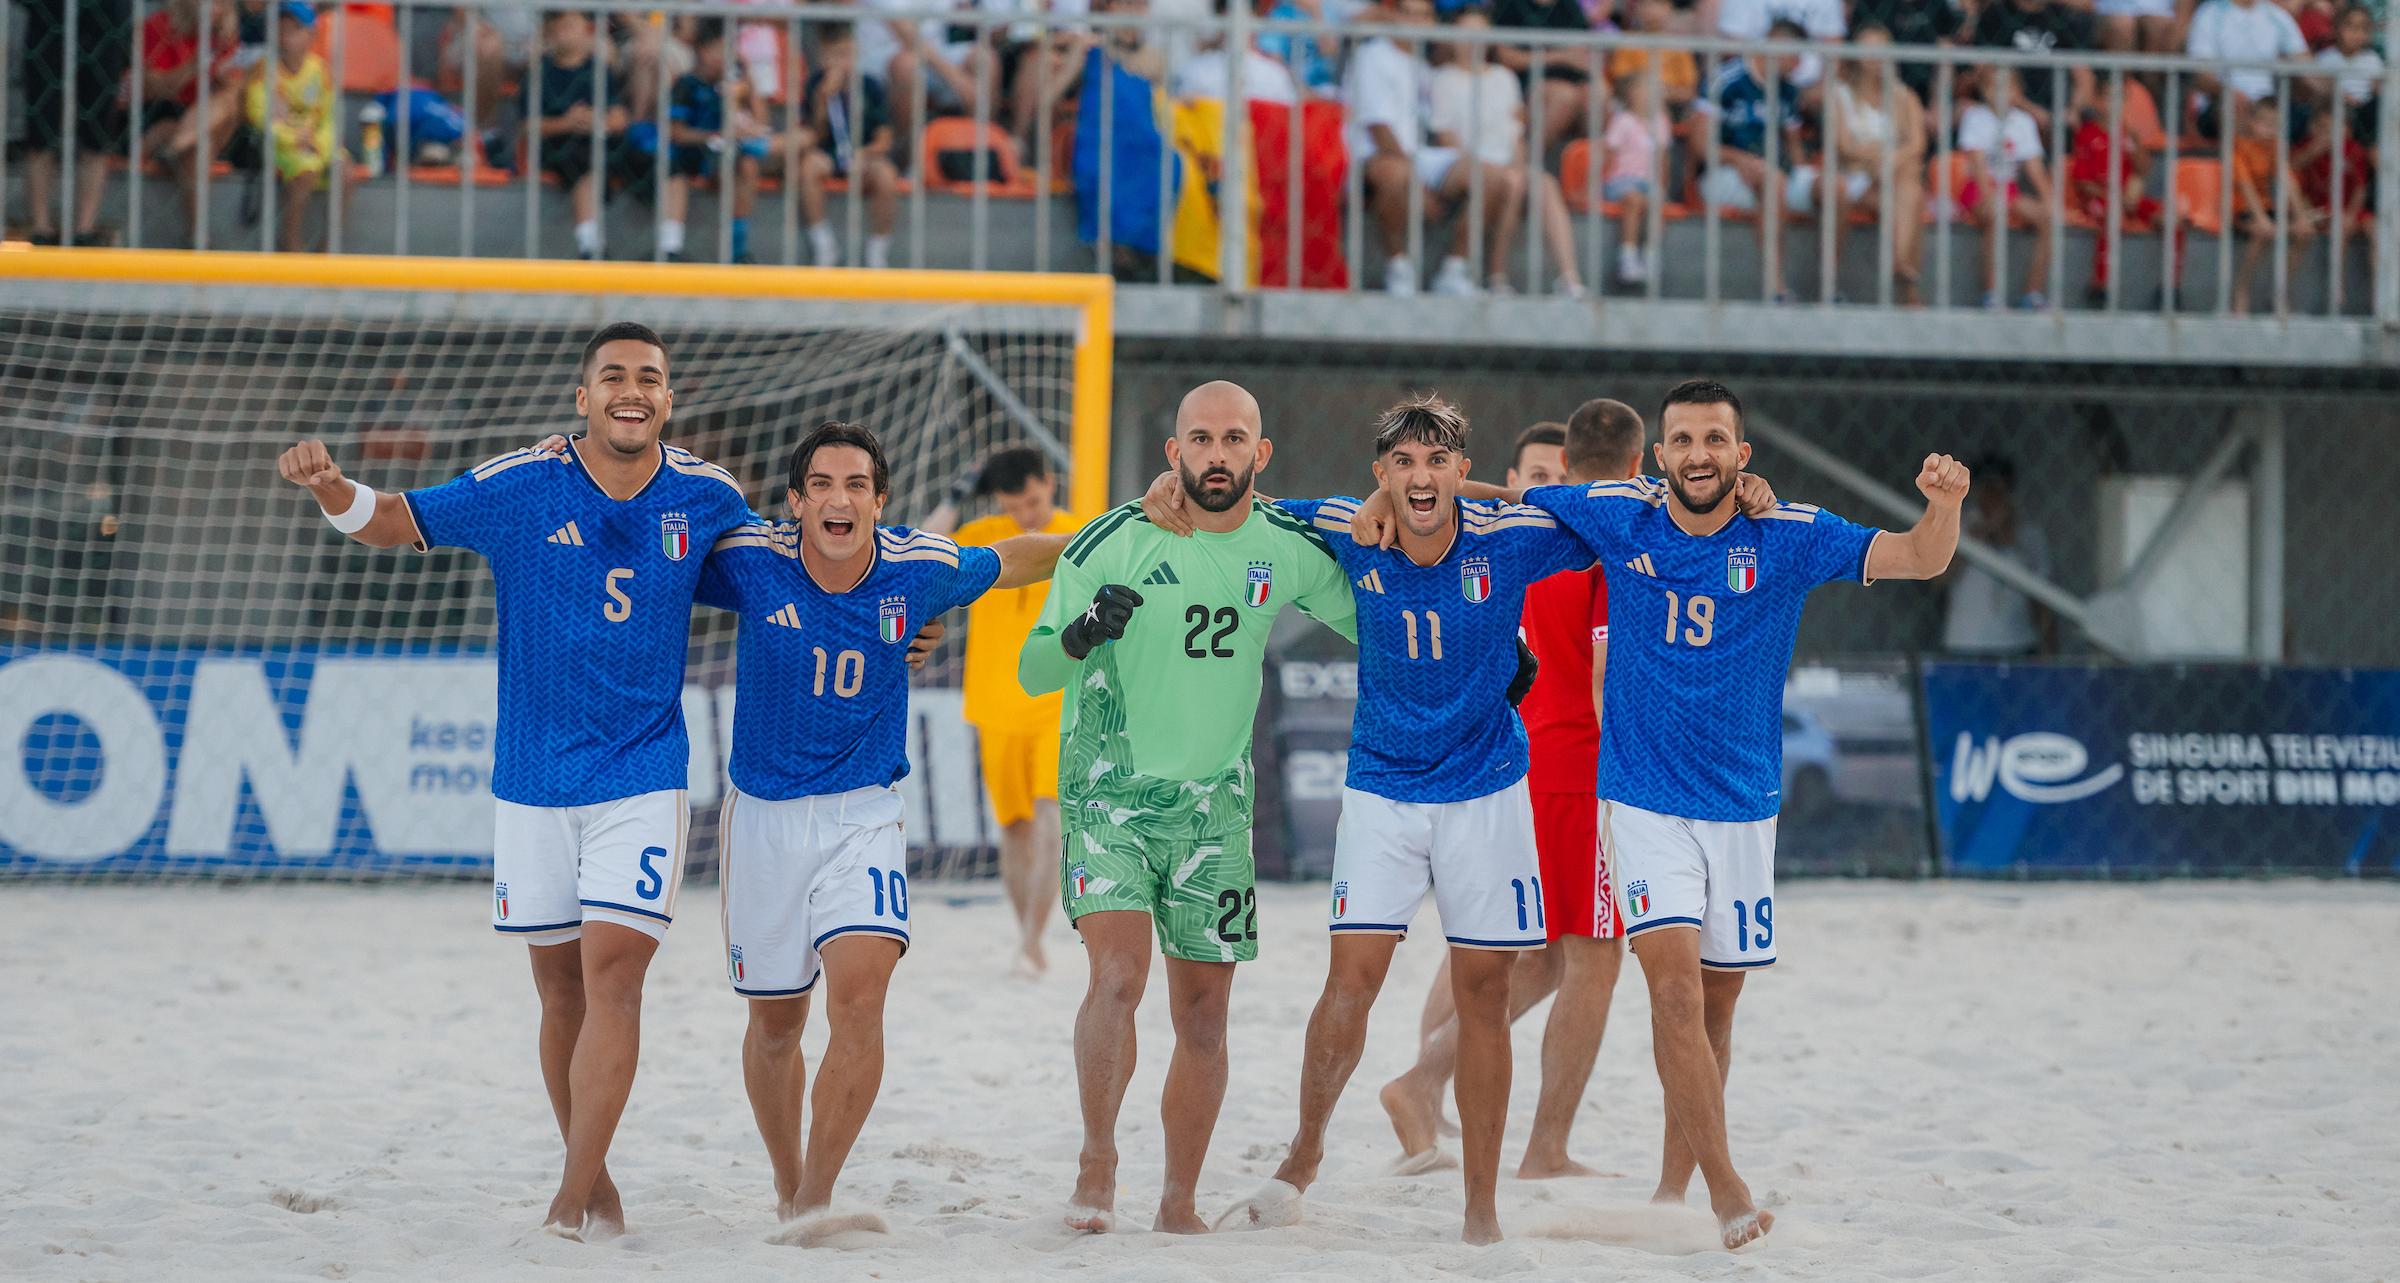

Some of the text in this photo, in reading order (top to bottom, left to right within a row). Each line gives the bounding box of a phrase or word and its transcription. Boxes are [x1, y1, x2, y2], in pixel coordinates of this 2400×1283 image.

[663, 522, 687, 531] ITALIA
[1249, 570, 1270, 579] ITALIA
[1463, 566, 1488, 576] ITALIA
[1729, 556, 1754, 566] ITALIA
[604, 568, 634, 622] 5
[881, 606, 904, 616] ITALIA
[1665, 591, 1715, 647] 19
[1184, 604, 1239, 659] 22
[1402, 610, 1442, 660] 11
[813, 647, 865, 698] 10
[409, 713, 496, 751] kee
[2128, 732, 2269, 768] SINGURA
[2131, 768, 2173, 805] DE
[2176, 768, 2269, 805] SPORT
[635, 846, 667, 901] 5
[867, 866, 908, 922] 10
[1217, 886, 1257, 943] 22
[1511, 876, 1544, 931] 11
[1733, 896, 1773, 952] 19
